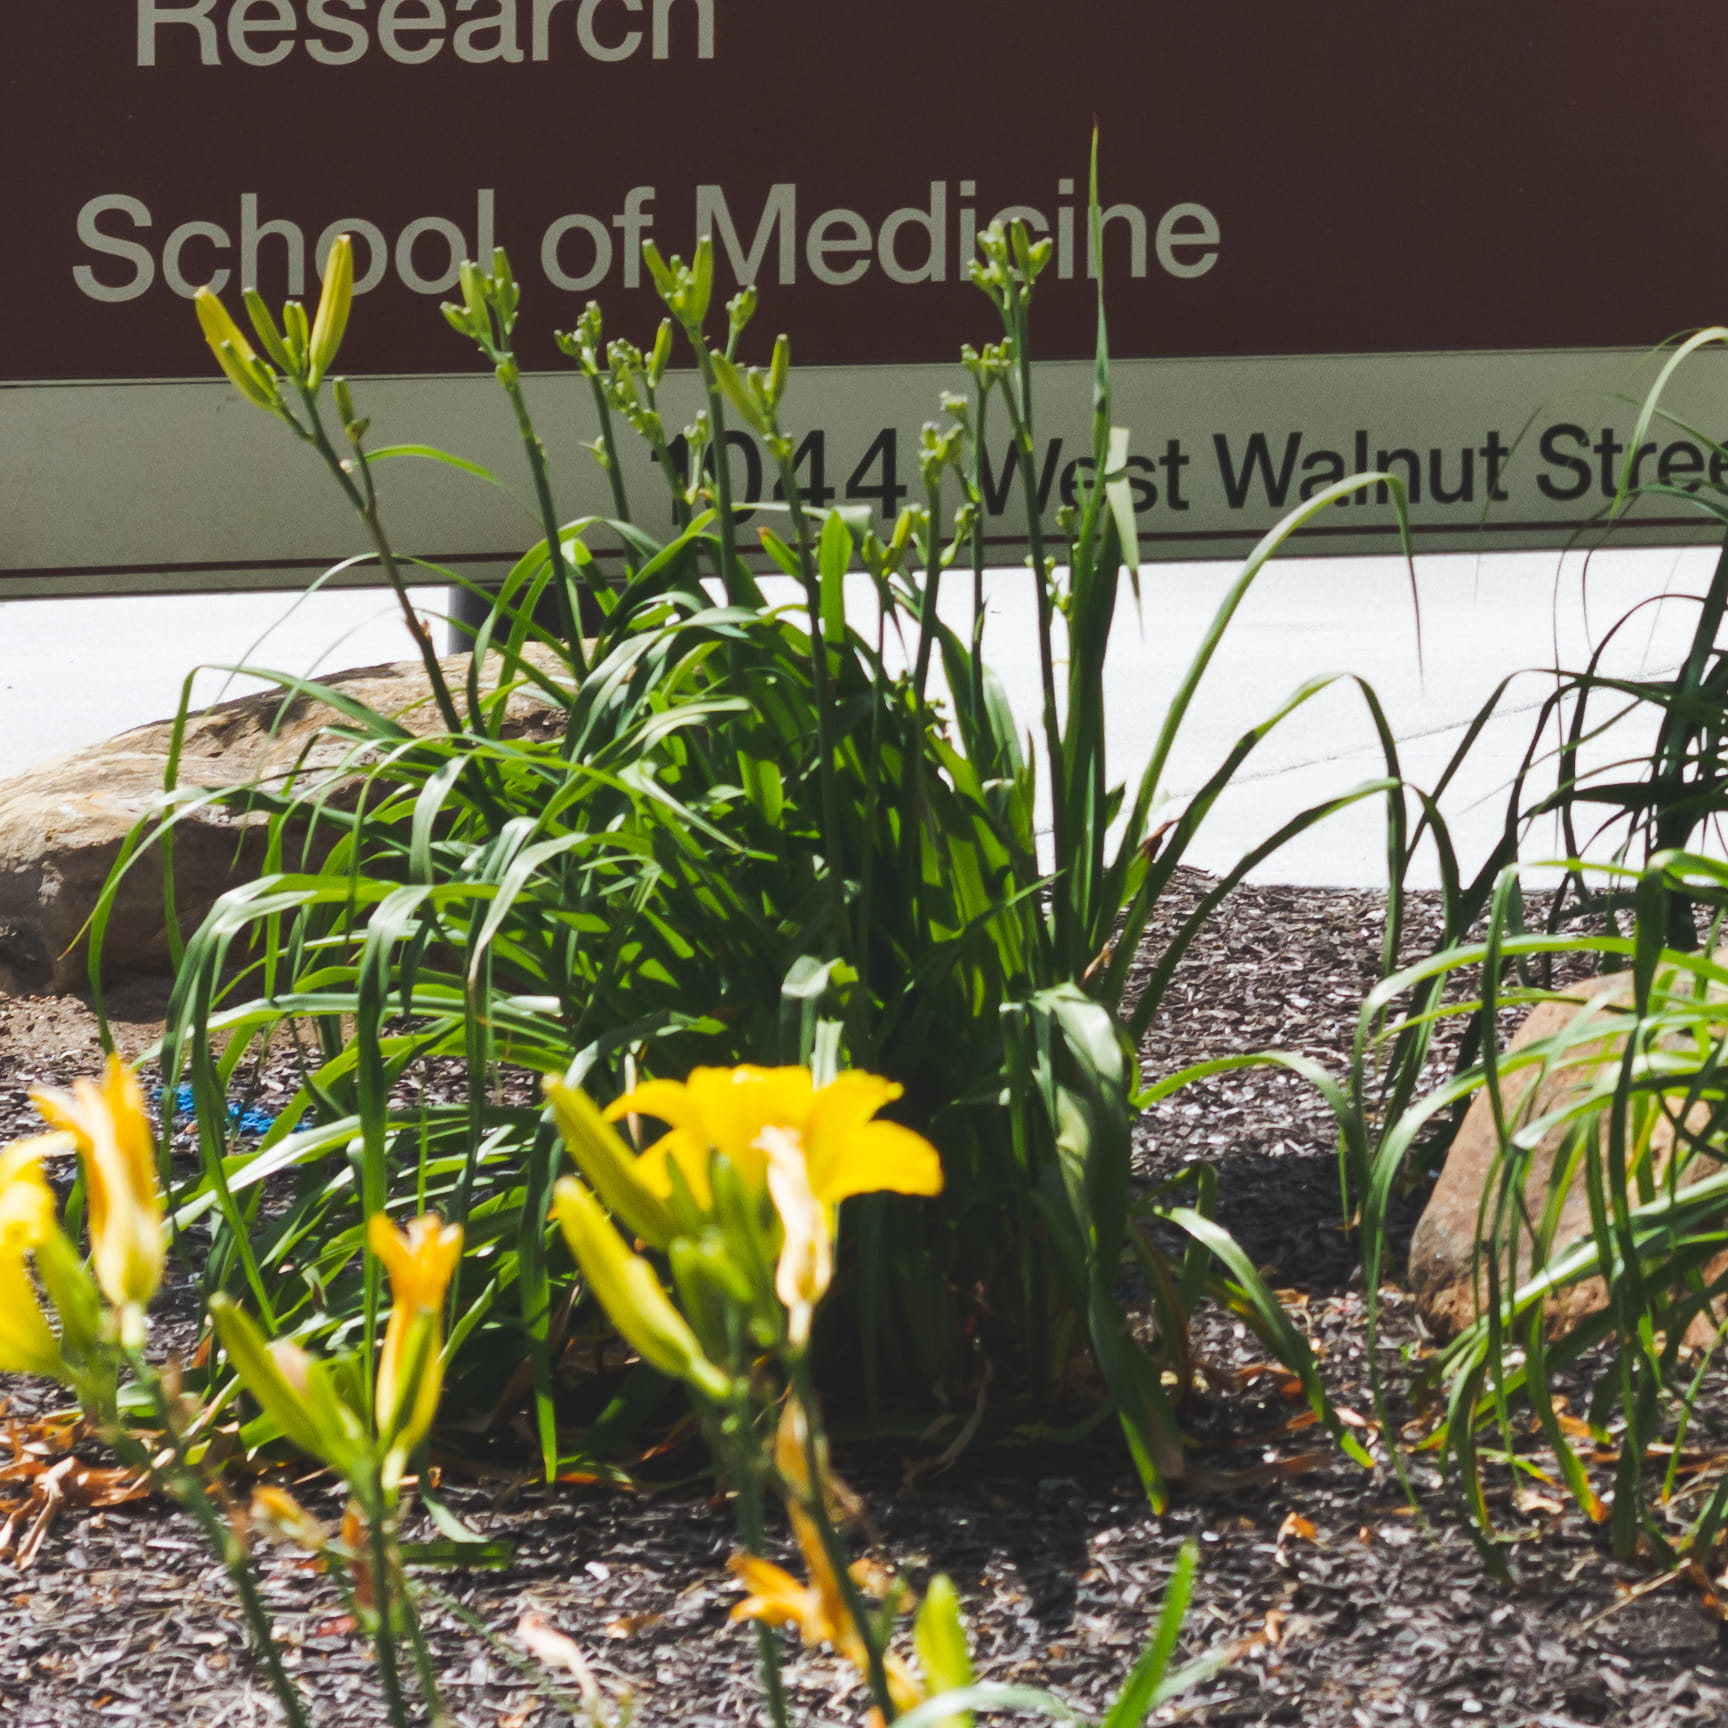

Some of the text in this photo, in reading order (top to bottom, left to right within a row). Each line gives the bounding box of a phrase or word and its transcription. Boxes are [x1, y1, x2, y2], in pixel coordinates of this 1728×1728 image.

[73, 178, 1220, 303] School of Medicine
[651, 427, 906, 527] 1044
[978, 436, 1190, 518] West
[1213, 428, 1509, 510] Walnut
